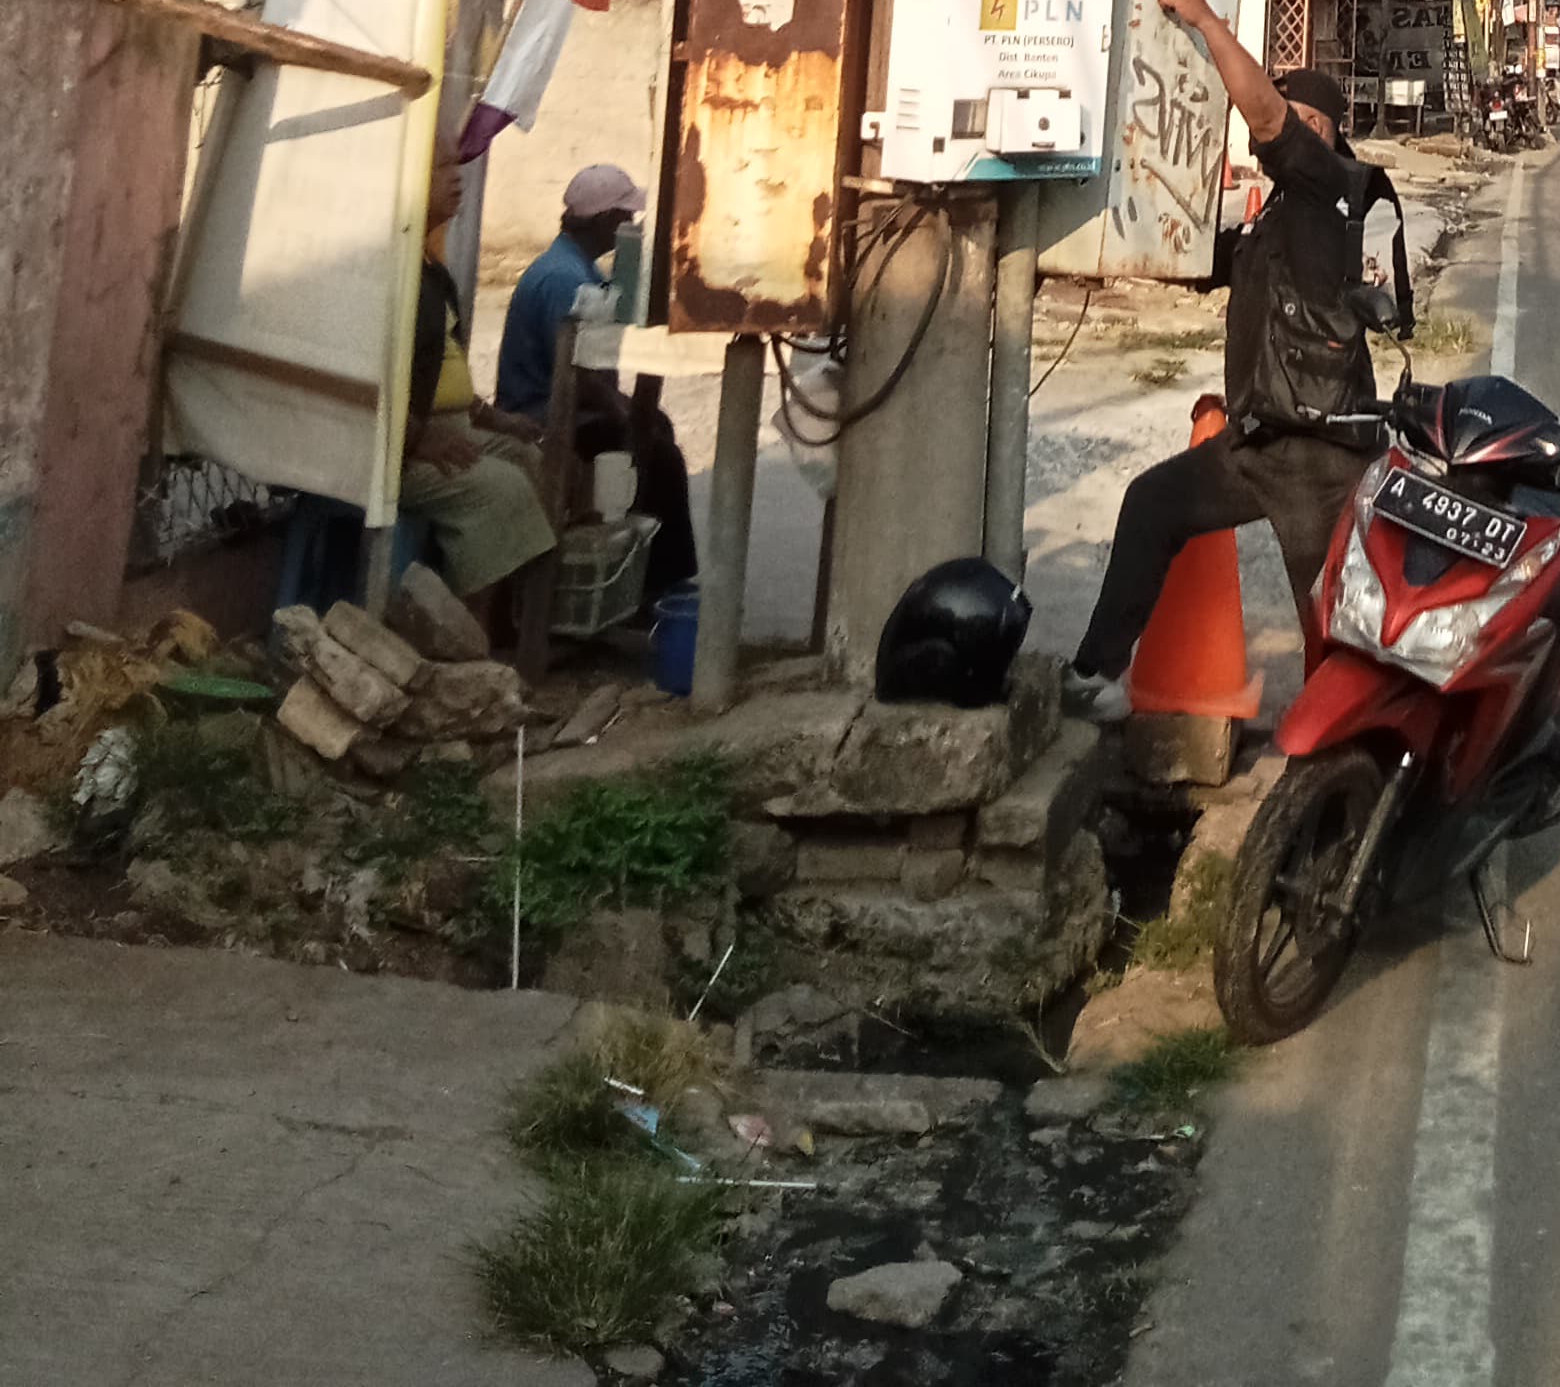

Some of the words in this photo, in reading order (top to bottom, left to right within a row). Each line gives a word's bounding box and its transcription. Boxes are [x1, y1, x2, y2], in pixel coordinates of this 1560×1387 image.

[1001, 35, 1021, 46] PLN
[1024, 35, 1074, 48] (PERSERO)
[1390, 477, 1406, 498] A
[1422, 491, 1478, 527] 4937
[1485, 517, 1515, 543] DT
